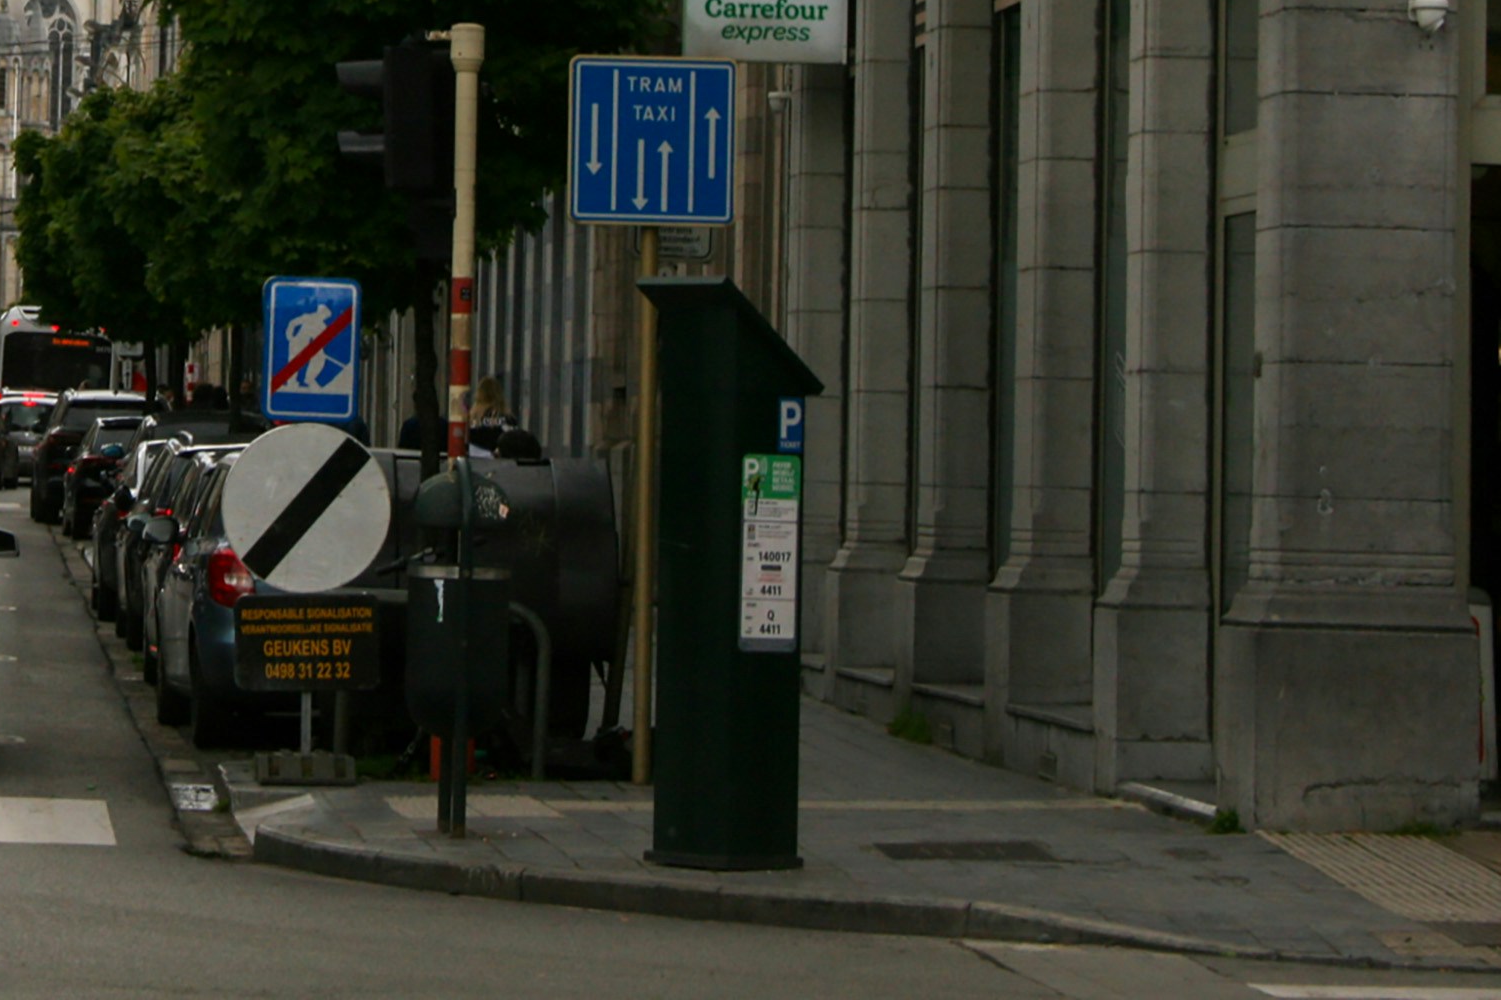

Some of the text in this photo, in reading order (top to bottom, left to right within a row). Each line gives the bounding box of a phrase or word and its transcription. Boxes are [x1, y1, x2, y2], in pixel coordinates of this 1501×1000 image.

[721, 22, 811, 44] express
[627, 76, 683, 94] TRAM
[633, 105, 676, 122] TAXI
[780, 400, 803, 440] P
[744, 458, 759, 487] P
[758, 551, 792, 562] 140017
[760, 585, 782, 596] 4411
[241, 607, 372, 620] RESPONSABLE SIGNALISATION
[767, 609, 775, 621] Q
[324, 622, 373, 632] SIGNALISATIE
[759, 623, 781, 634] 4411
[263, 639, 352, 657] GEUKENS BV
[265, 661, 352, 679] 0498 31 22 32
